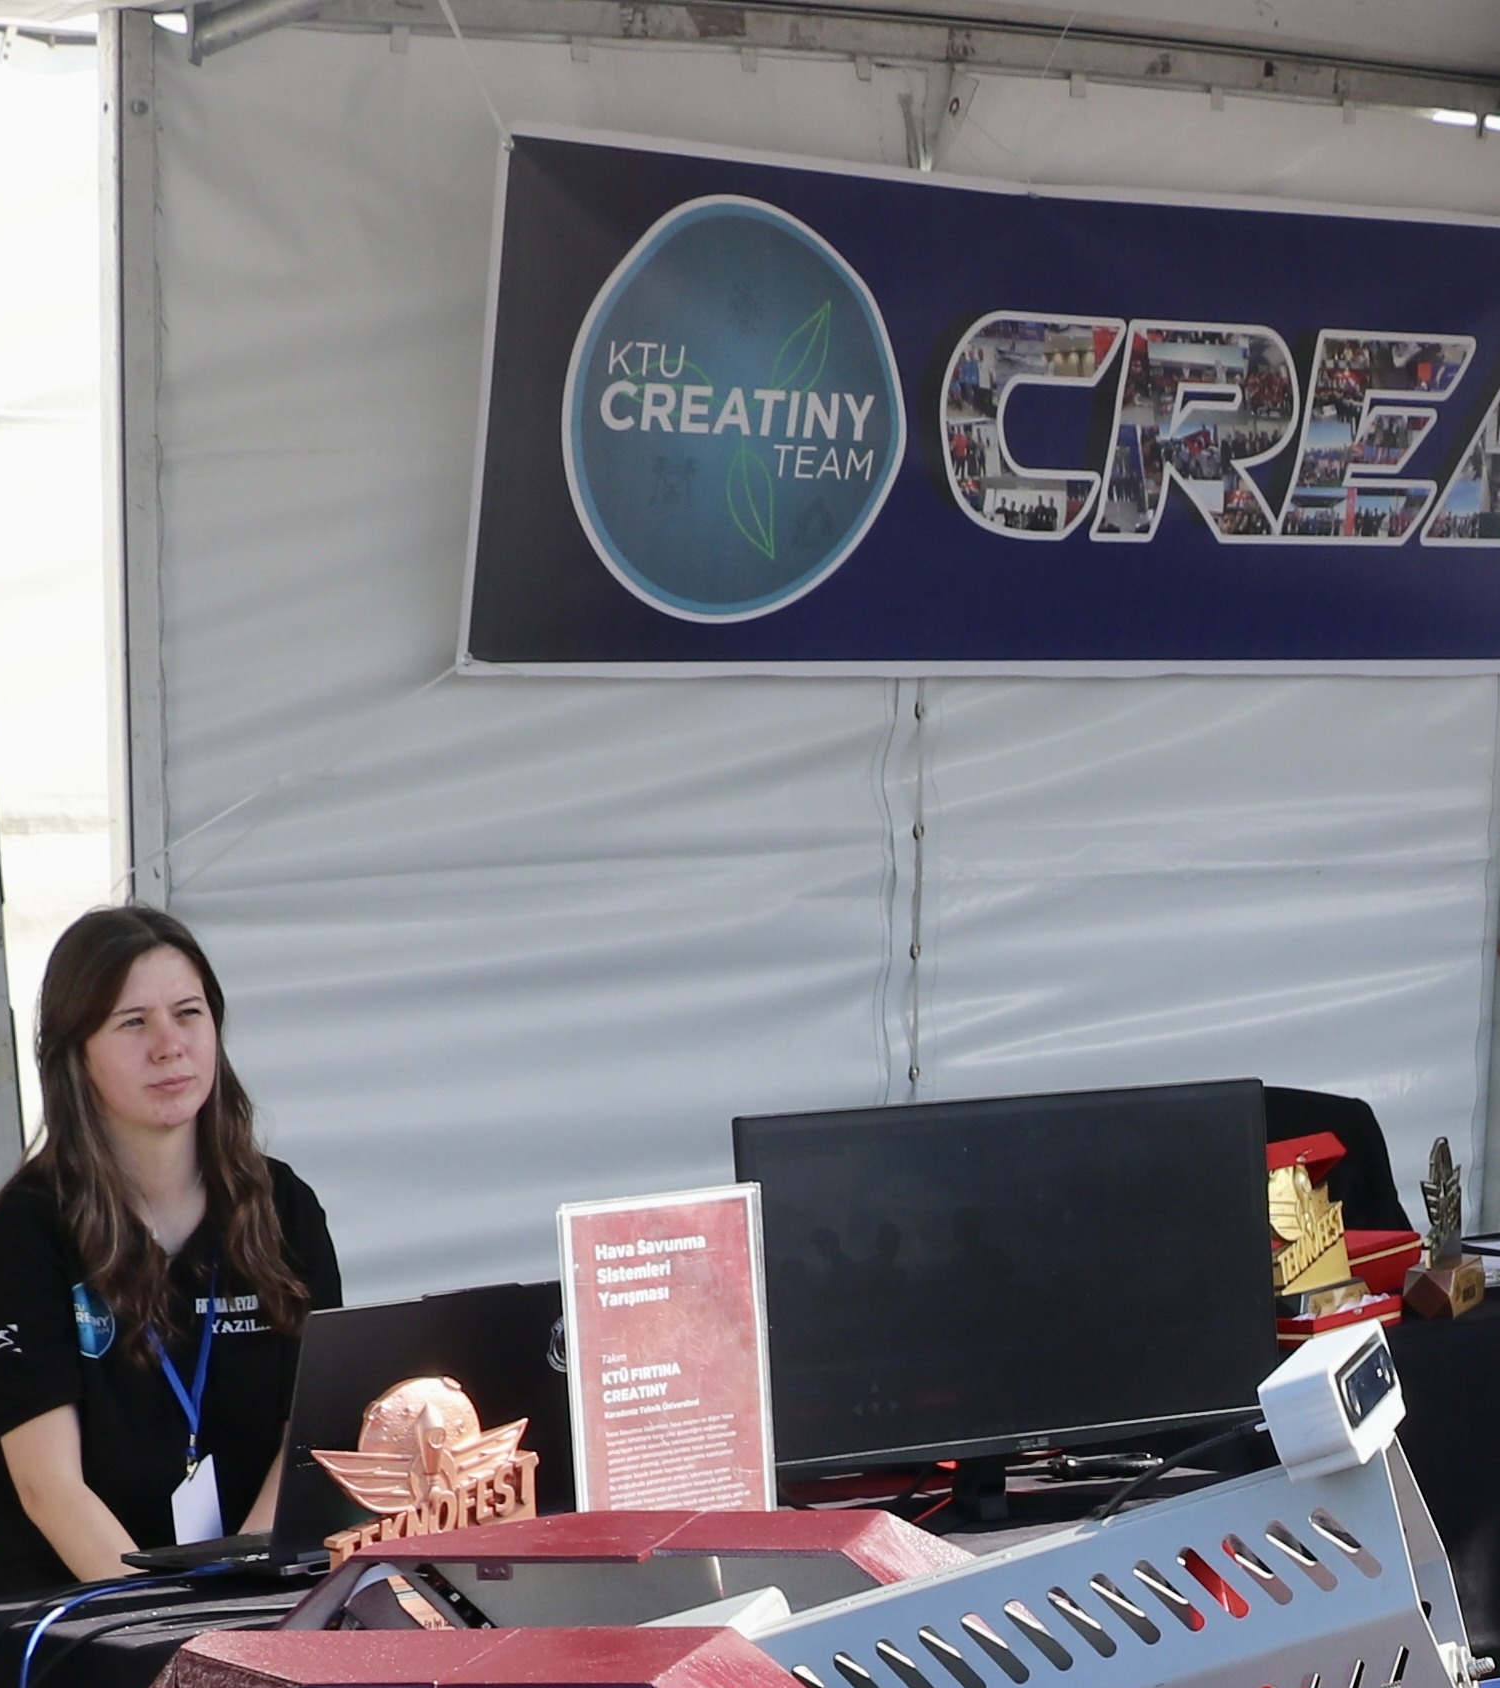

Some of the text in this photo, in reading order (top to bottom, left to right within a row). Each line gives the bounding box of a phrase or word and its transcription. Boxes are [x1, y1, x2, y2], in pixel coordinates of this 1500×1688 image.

[607, 340, 686, 379] KTU
[600, 378, 876, 442] CREATINY
[772, 443, 875, 481] TEAM
[594, 1234, 707, 1261] Hava Savunma
[1278, 1200, 1345, 1286] TEKNOFEST
[596, 1259, 672, 1285] Sistemleri
[597, 1286, 670, 1309] Yarışması
[211, 1318, 272, 1335] YAZIL
[601, 1352, 627, 1365] Takım
[601, 1361, 682, 1386] KTÜ FIRTINA
[602, 1382, 668, 1404] CREATINY
[604, 1407, 639, 1420] Karadeniz
[639, 1403, 662, 1415] Teknik
[323, 1449, 540, 1573] TEKNOFEST
